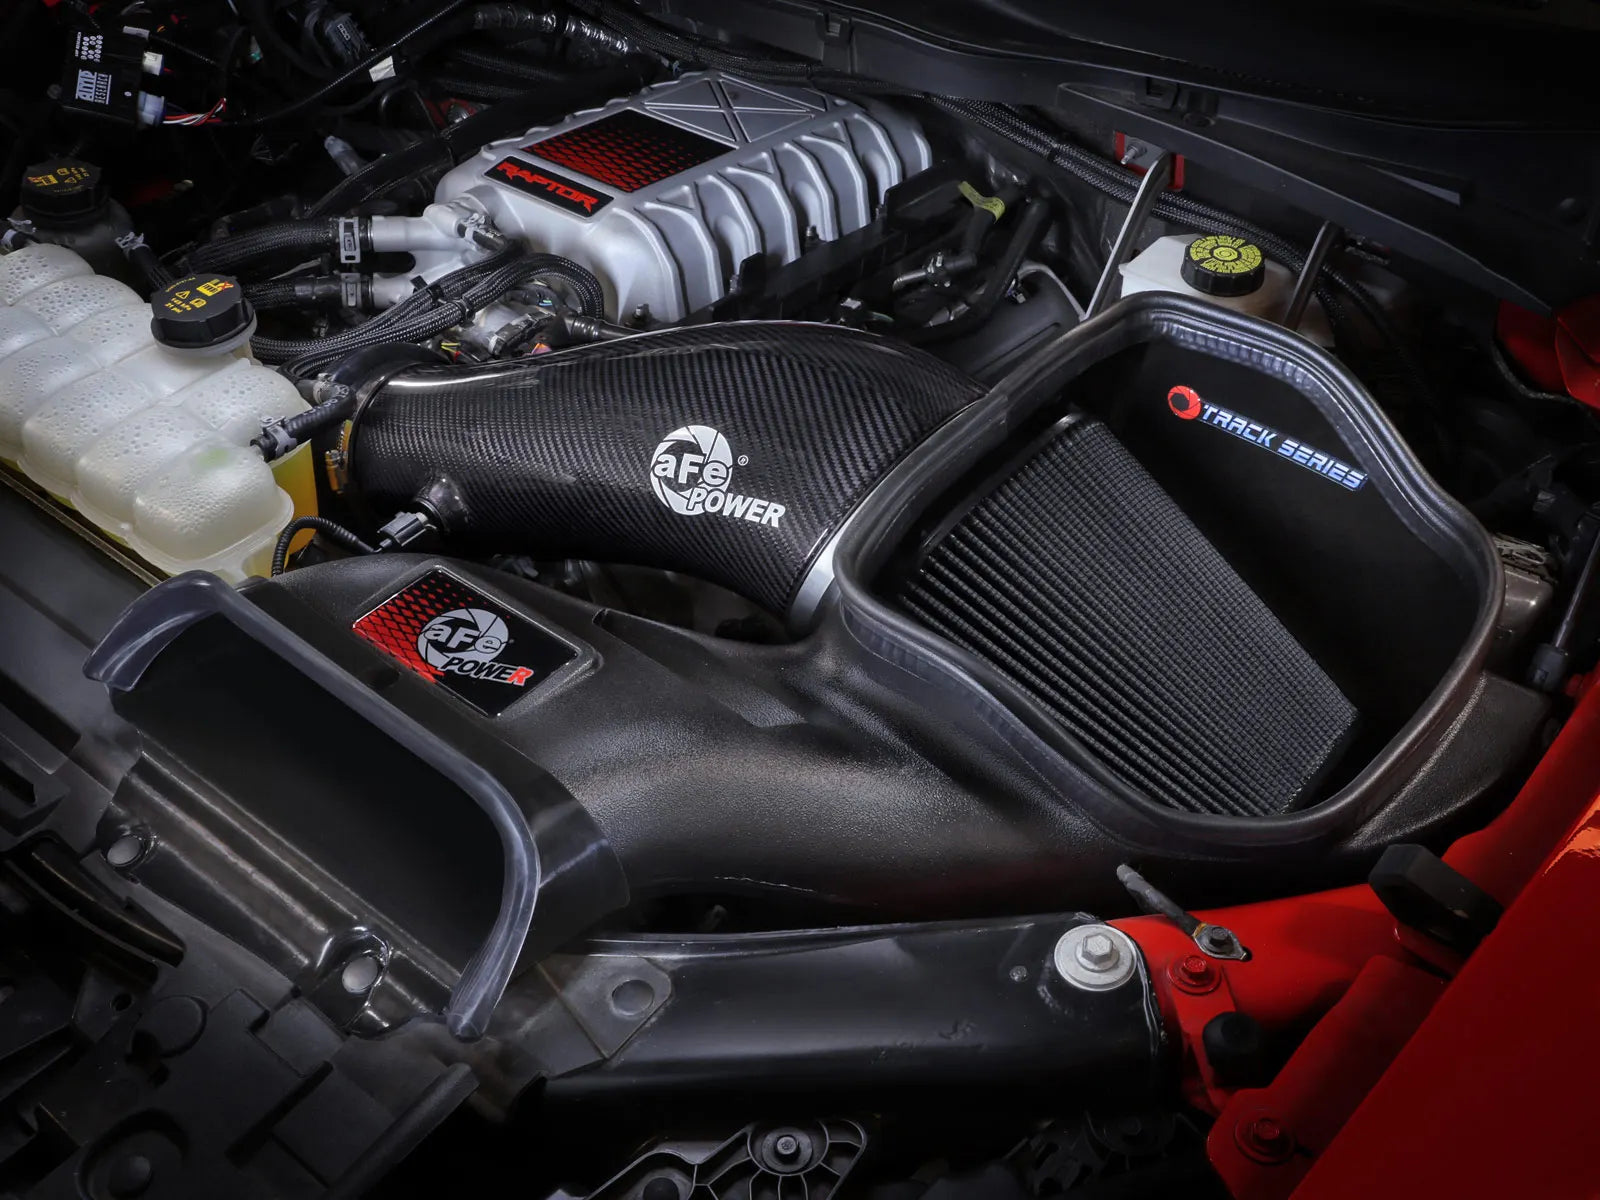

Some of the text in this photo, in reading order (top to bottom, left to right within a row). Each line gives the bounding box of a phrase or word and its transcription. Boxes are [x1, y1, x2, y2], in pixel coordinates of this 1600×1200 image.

[94, 73, 108, 104] RESEARCH
[497, 161, 599, 213] RAPTOR
[1202, 404, 1368, 490] TRACK SERIES
[653, 453, 728, 487] aFe
[688, 487, 786, 528] POWER
[424, 624, 501, 654] aFe
[439, 656, 534, 686] POWER
